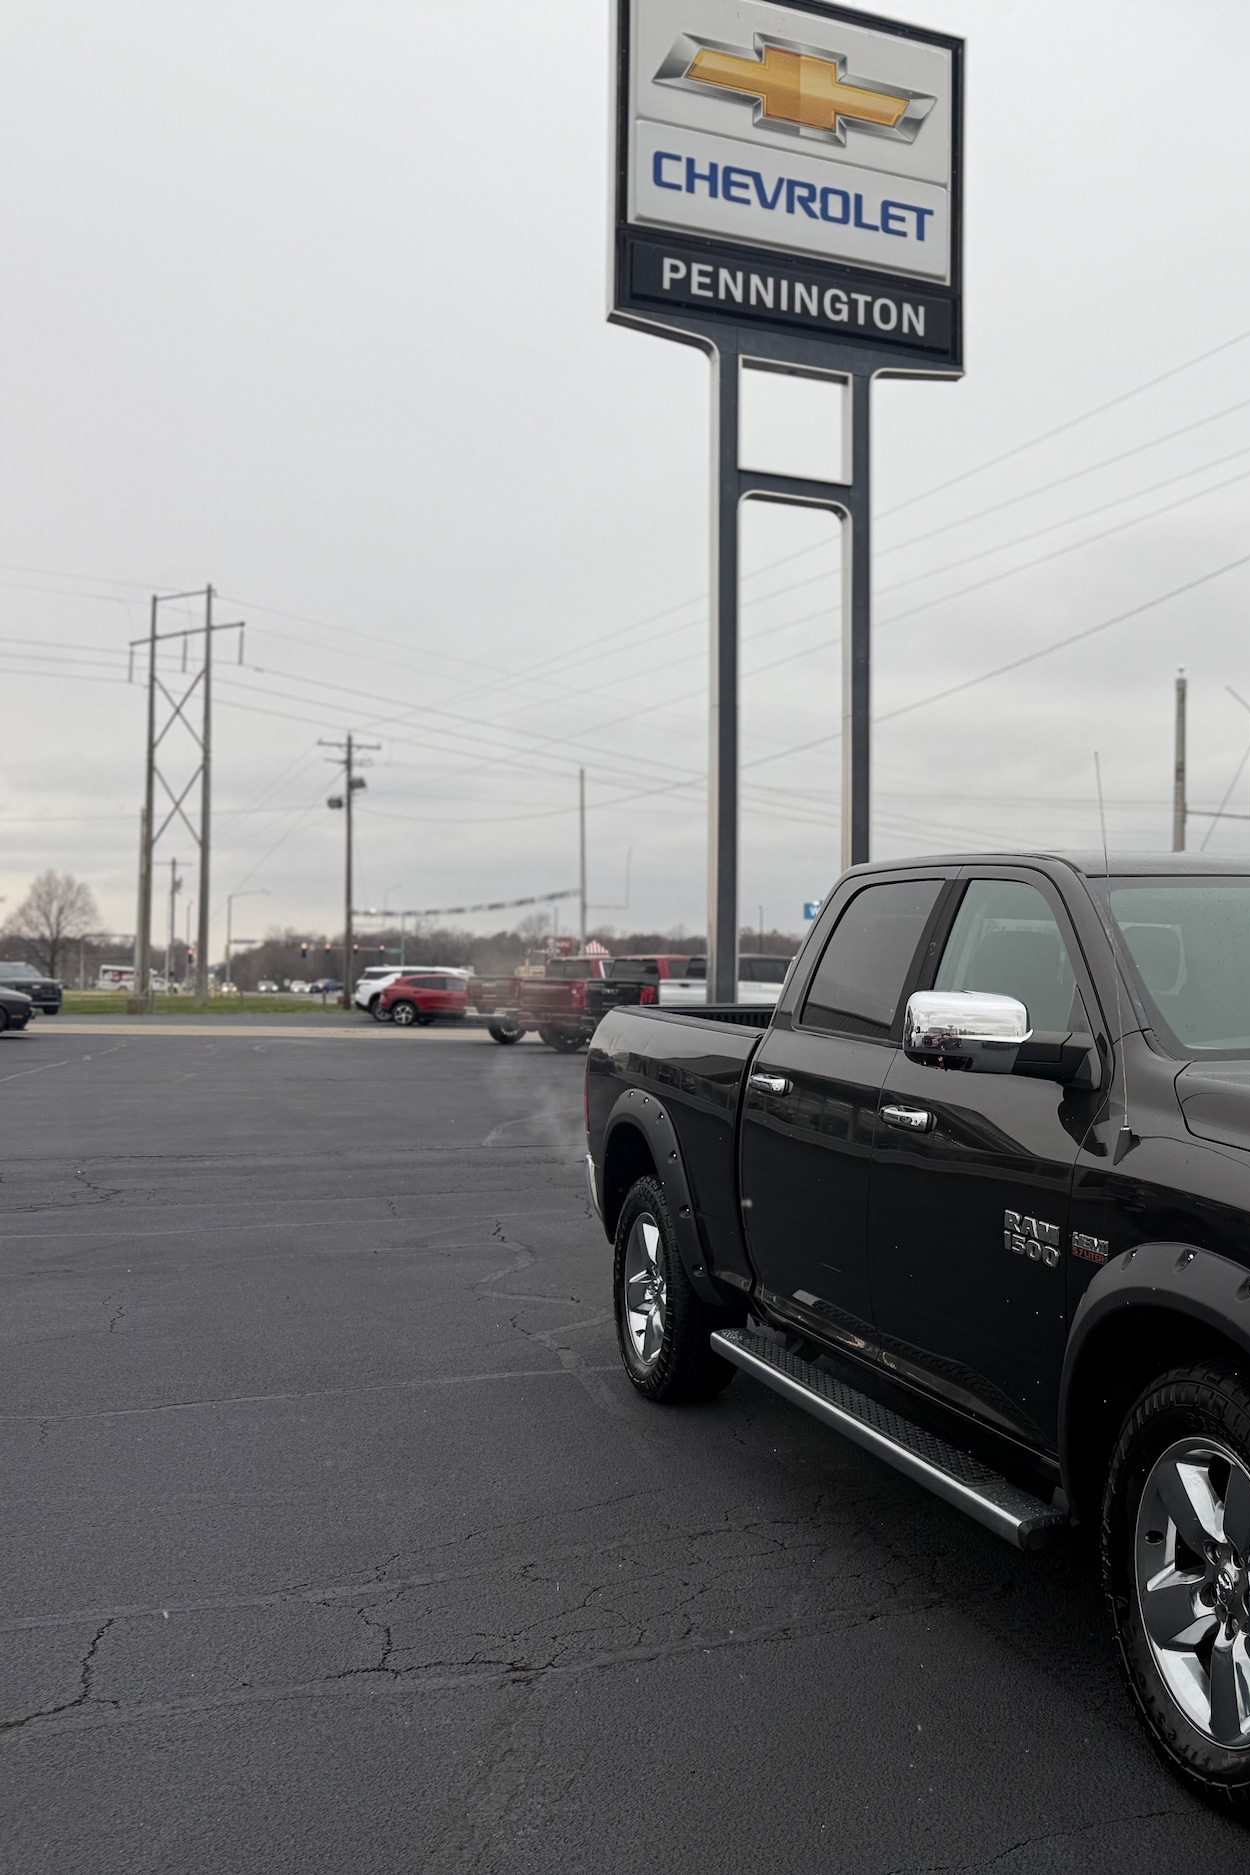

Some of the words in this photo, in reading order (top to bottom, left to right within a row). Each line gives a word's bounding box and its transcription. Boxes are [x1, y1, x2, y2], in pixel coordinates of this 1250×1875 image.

[652, 150, 934, 242] CHEVROLET
[661, 257, 926, 337] PENNINGTON
[1004, 1209, 1060, 1246] RAM
[1003, 1230, 1060, 1268] 1500
[1084, 1249, 1105, 1263] LITER
